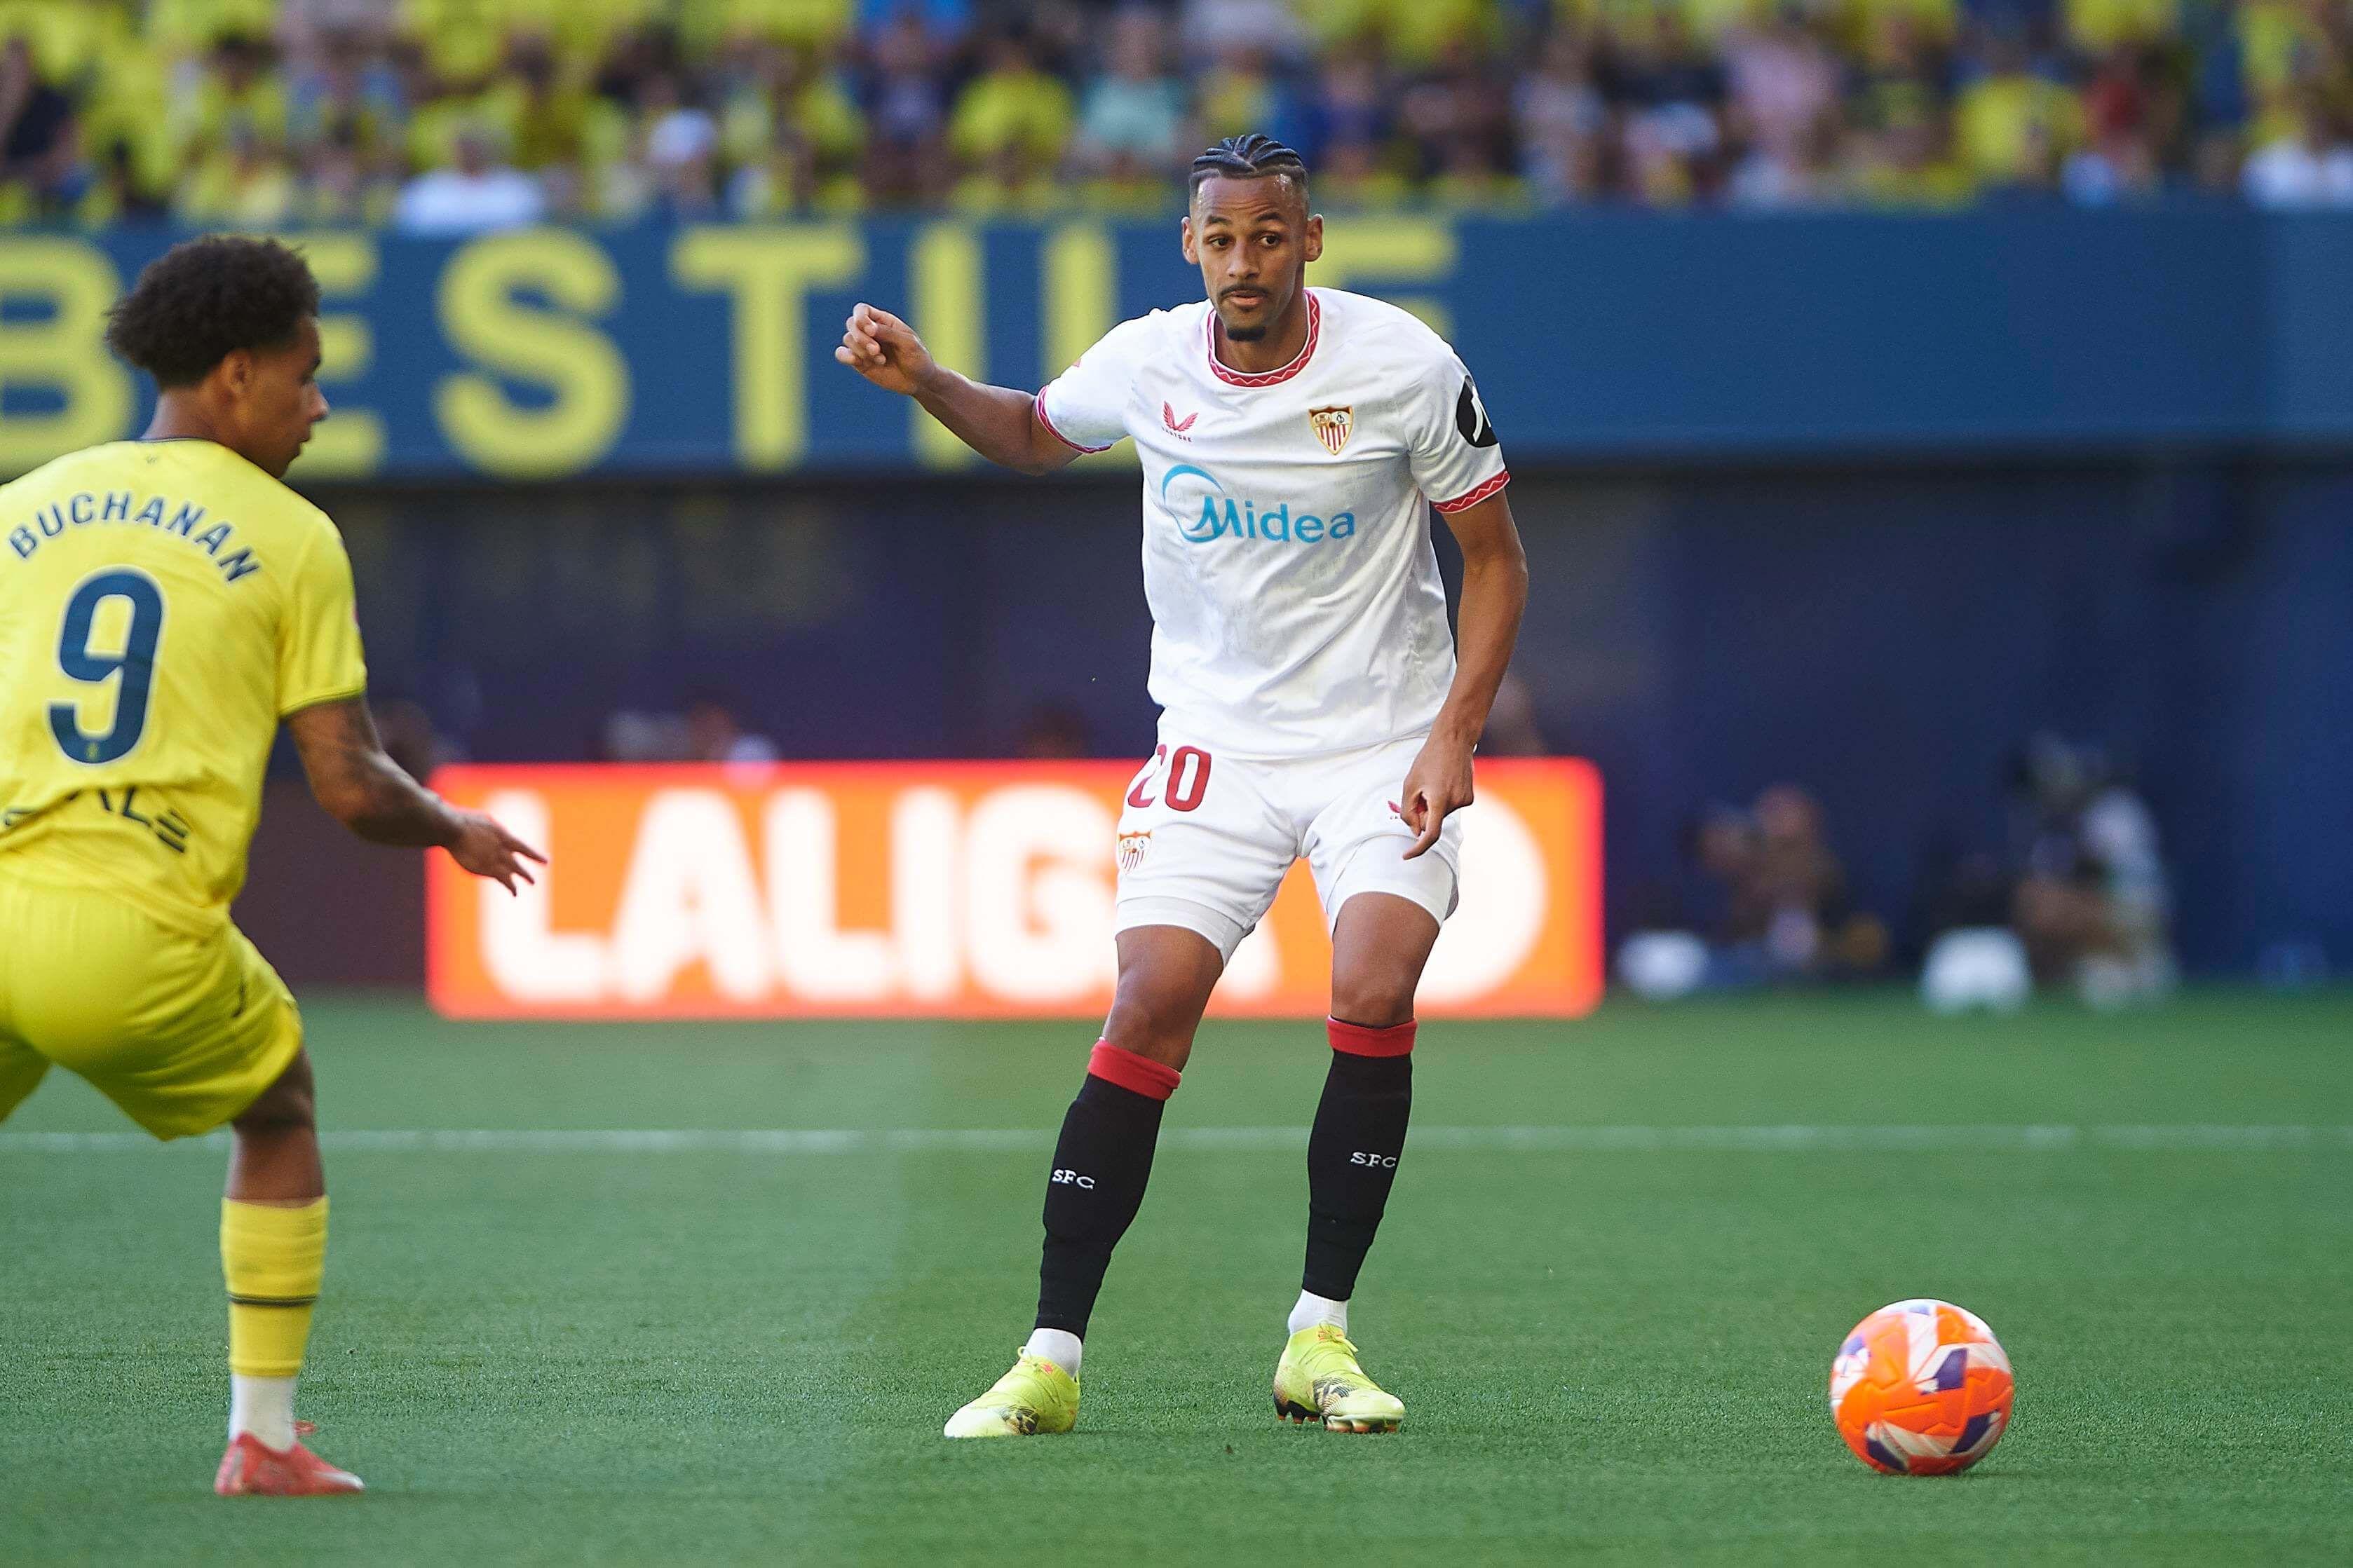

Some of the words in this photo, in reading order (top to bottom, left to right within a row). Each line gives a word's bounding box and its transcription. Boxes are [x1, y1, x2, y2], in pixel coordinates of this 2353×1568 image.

[8, 491, 260, 582] BUCHANAN
[1176, 493, 1355, 544] Midea
[48, 566, 163, 765] 9
[1127, 744, 1212, 812] 20
[1052, 1168, 1096, 1190] SFC
[1350, 1151, 1397, 1168] SFC
